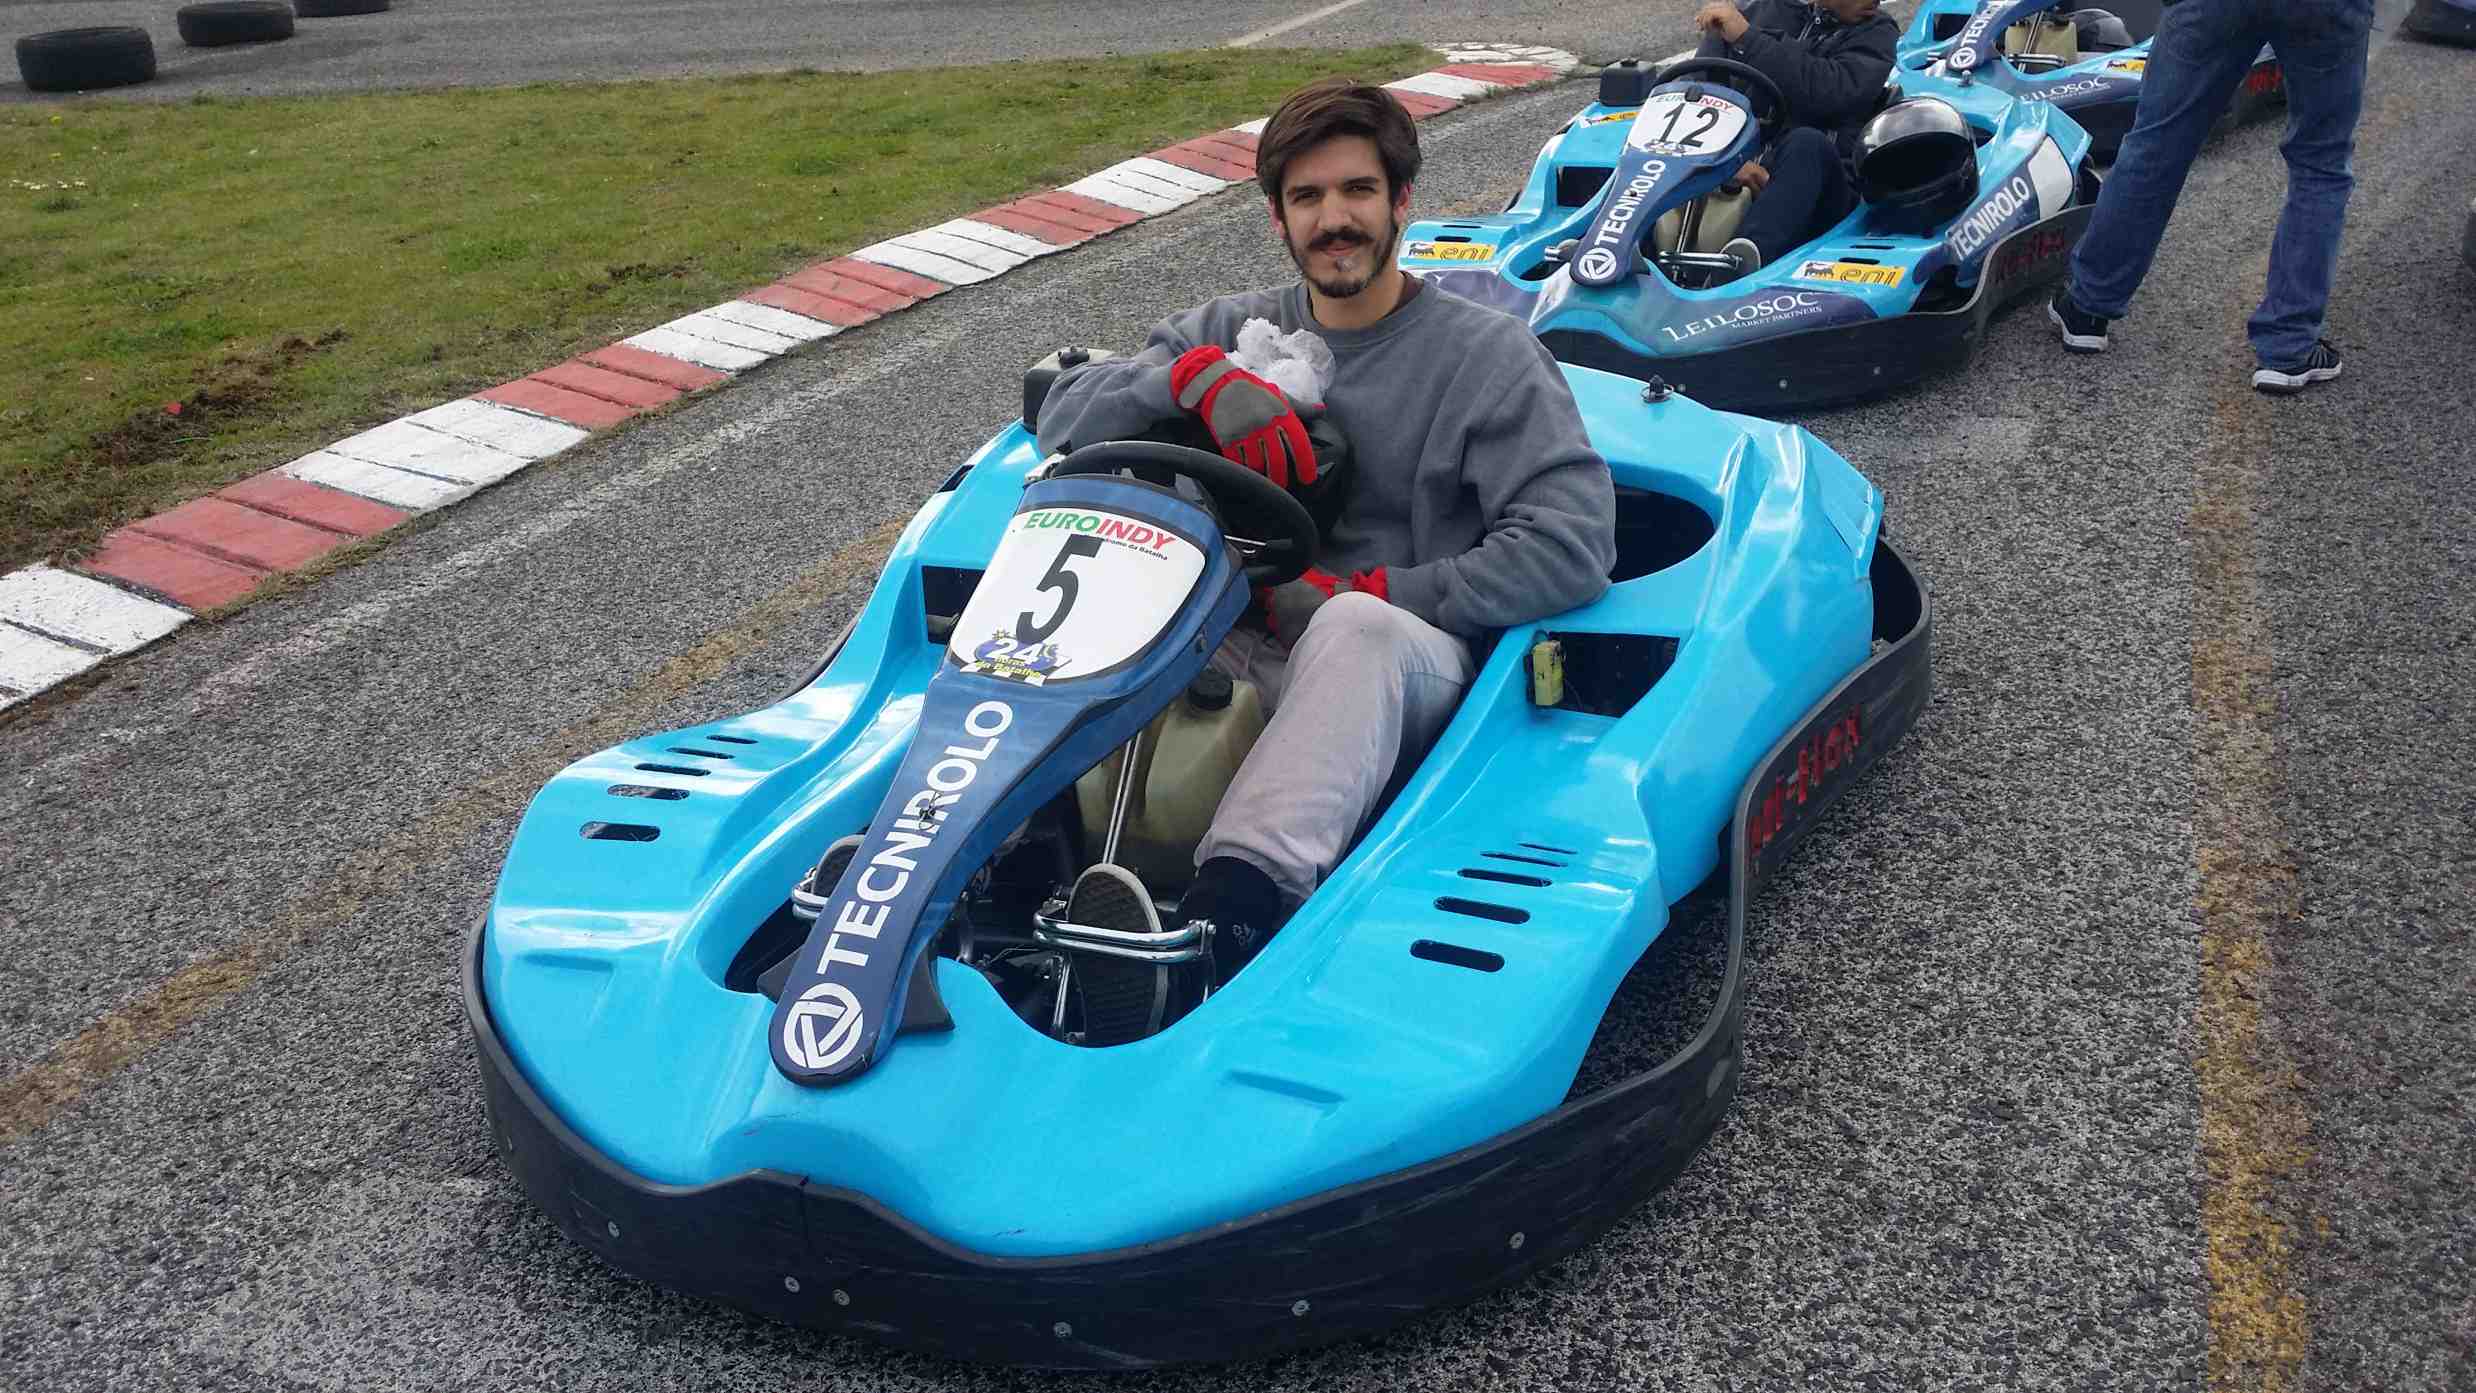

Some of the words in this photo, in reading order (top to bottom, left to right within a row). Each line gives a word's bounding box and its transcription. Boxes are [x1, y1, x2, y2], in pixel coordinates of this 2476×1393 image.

[1660, 103, 1719, 148] 12
[1595, 159, 1667, 244] TECNIROLO
[1945, 176, 2030, 262] TECNIROLO
[1840, 268, 1896, 287] eni
[1662, 291, 1820, 343] LEILOSOC
[1023, 512, 1176, 550] EUROINDY
[1016, 533, 1104, 645] 5
[984, 638, 1044, 665] 24
[816, 699, 1014, 975] TECNIROLO
